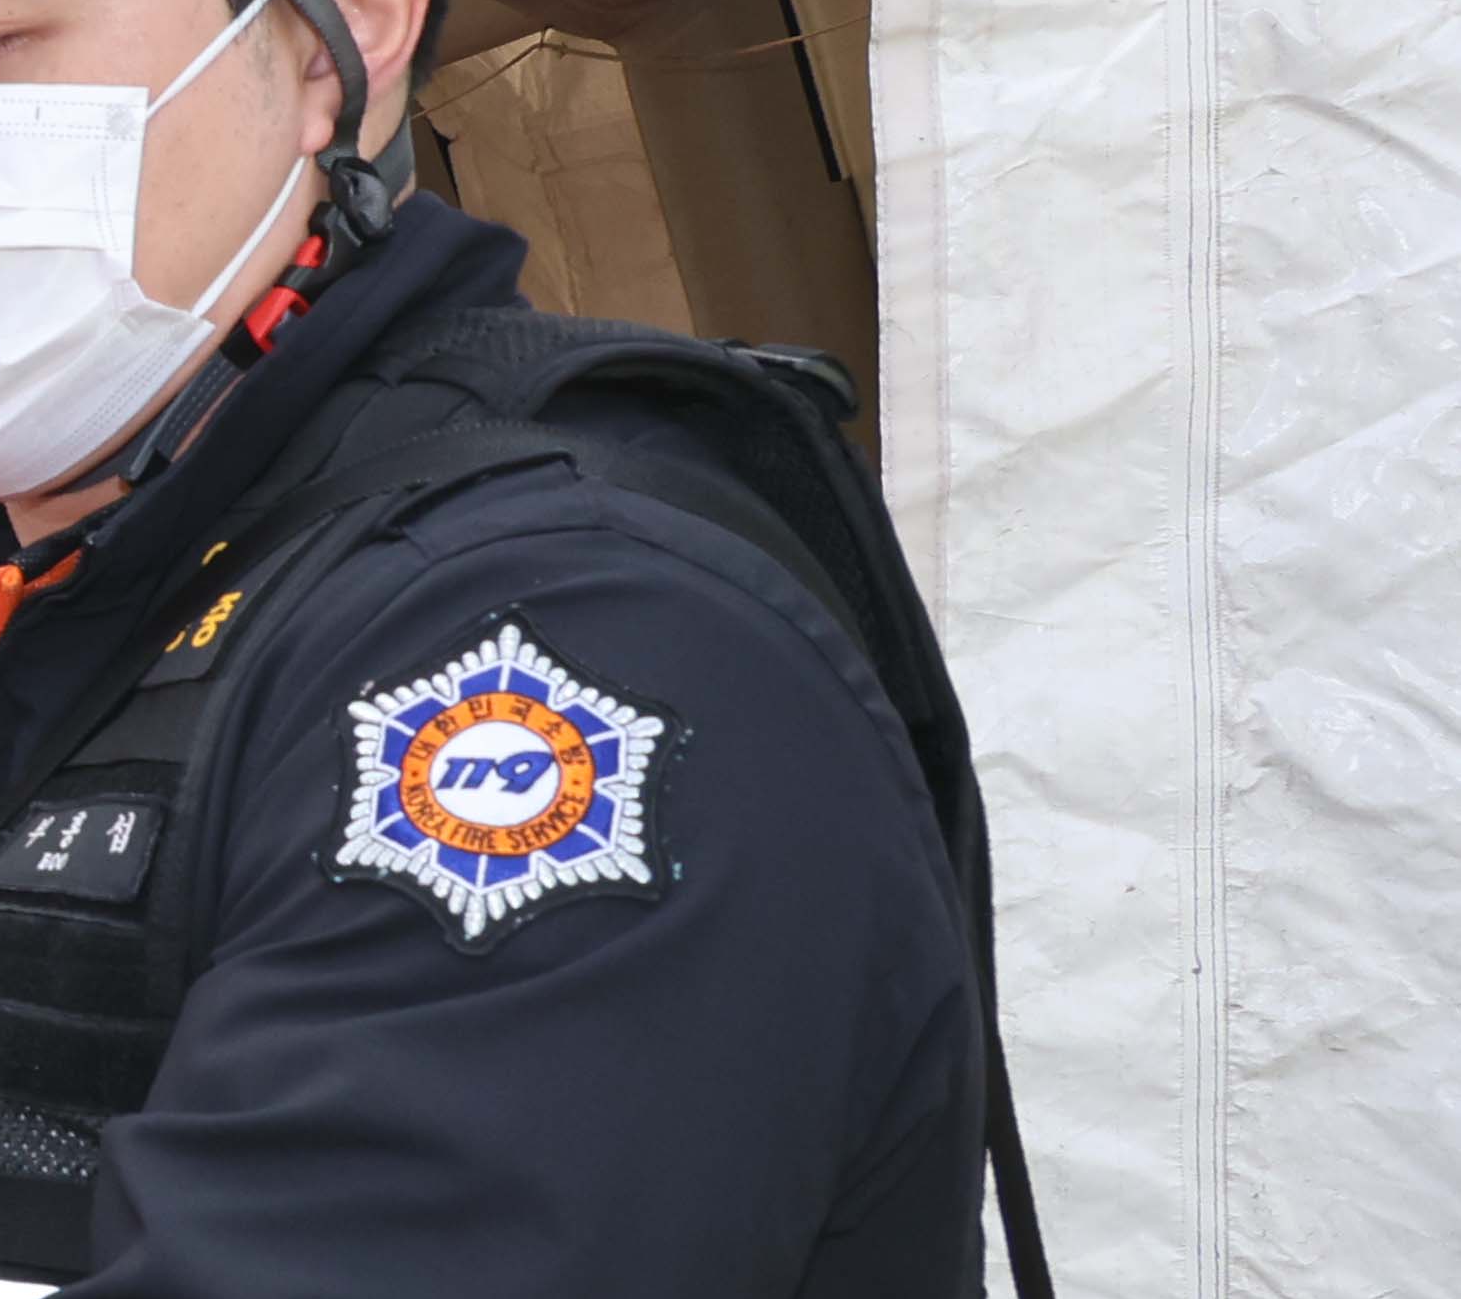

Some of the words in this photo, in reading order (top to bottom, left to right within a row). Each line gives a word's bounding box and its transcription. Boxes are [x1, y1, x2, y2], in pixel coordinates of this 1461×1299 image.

[435, 750, 558, 795] 119
[405, 781, 450, 838] KOREA
[449, 825, 497, 850] FIRE
[504, 791, 588, 852] SERVICE
